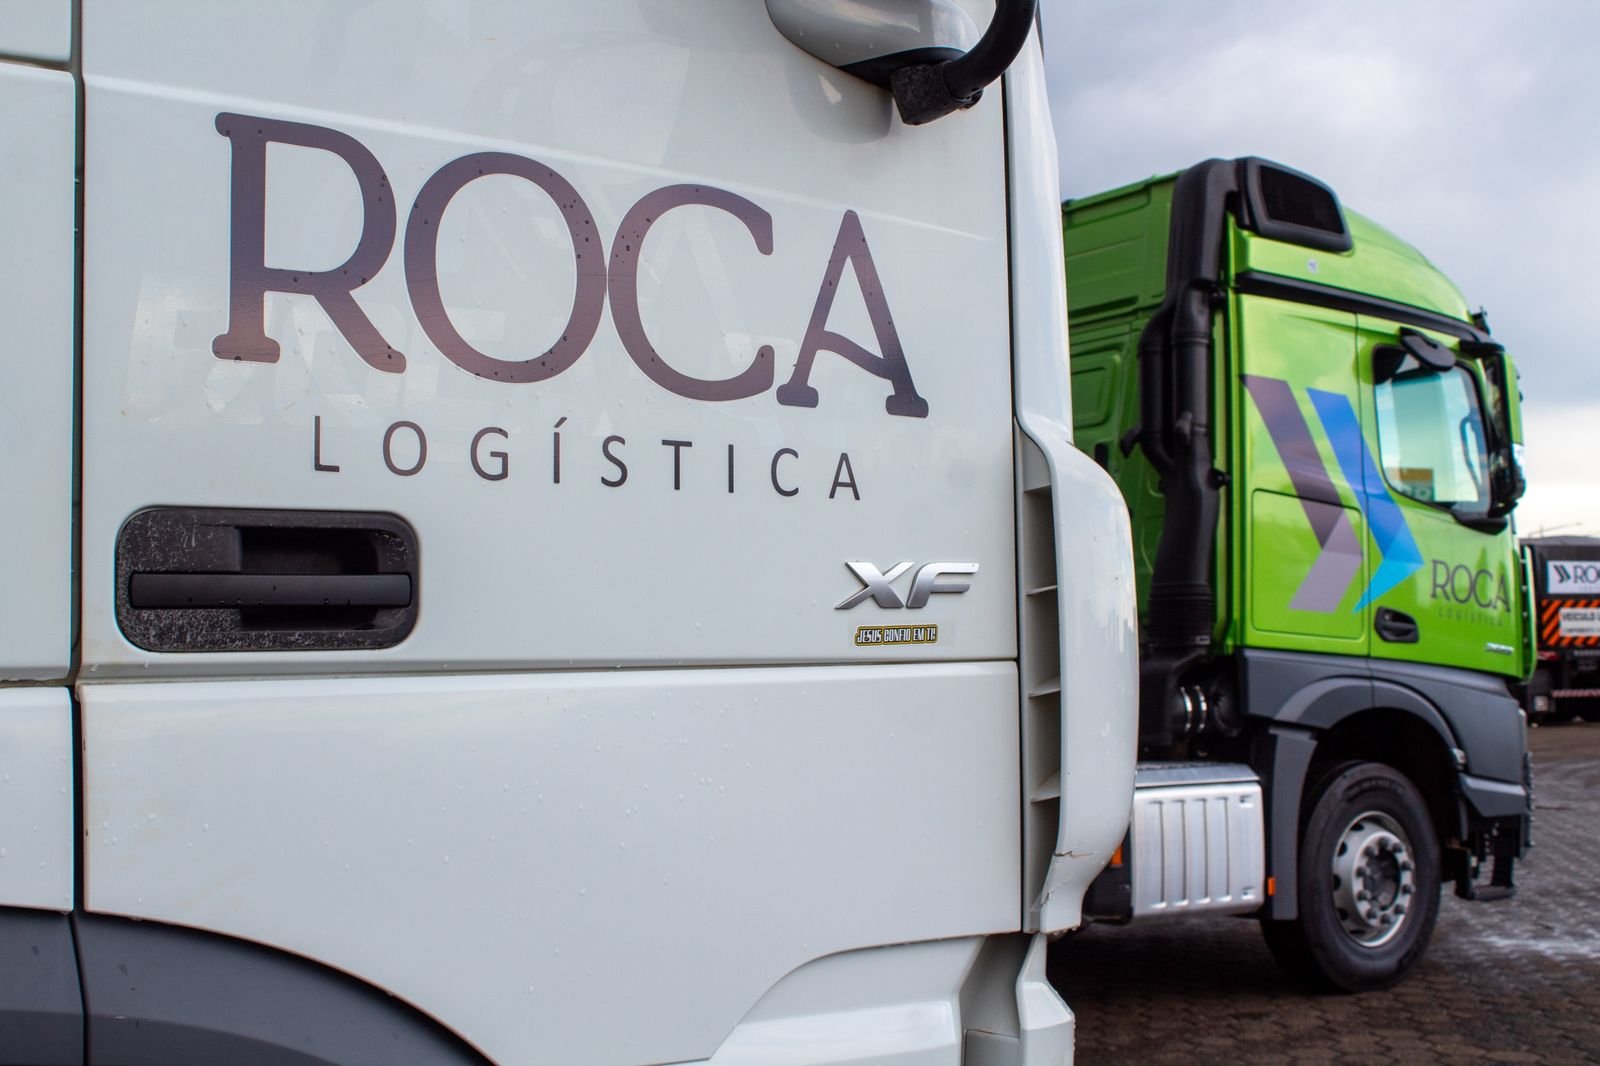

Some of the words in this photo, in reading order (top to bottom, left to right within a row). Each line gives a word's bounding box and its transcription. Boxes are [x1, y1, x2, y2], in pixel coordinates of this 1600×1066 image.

[211, 111, 930, 418] ROCA
[313, 415, 861, 501] LOGÍSTICA
[834, 561, 979, 610] XF
[1430, 559, 1510, 613] ROCA
[1573, 564, 1600, 584] RO
[856, 628, 882, 643] JESUS
[883, 627, 911, 642] CONFIO
[913, 627, 925, 641] EM
